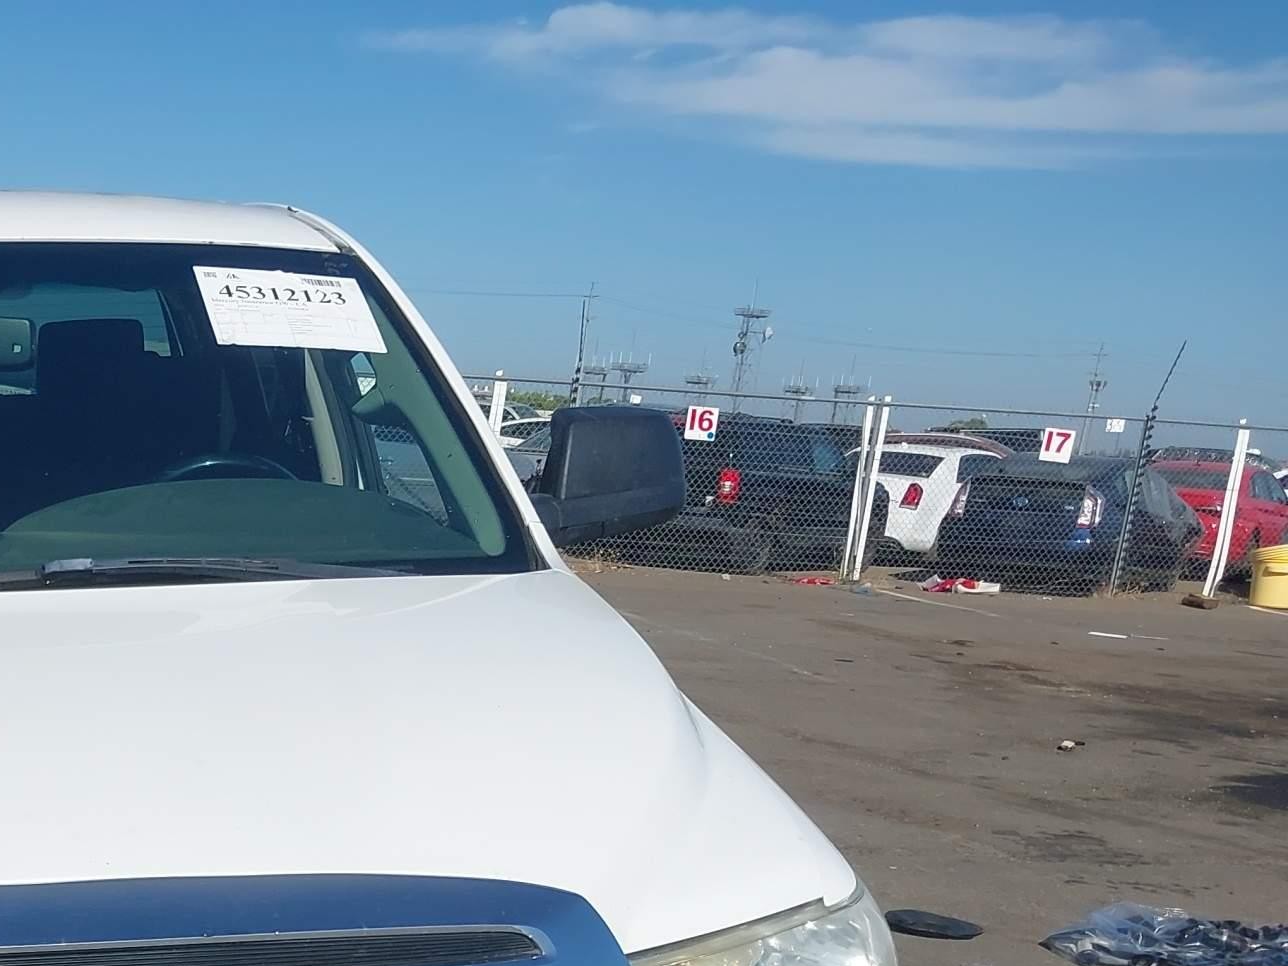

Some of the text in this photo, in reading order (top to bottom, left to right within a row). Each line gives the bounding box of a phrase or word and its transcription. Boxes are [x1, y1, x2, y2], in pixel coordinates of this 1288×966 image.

[218, 283, 347, 306] 45312123
[689, 408, 715, 432] 16
[1044, 430, 1072, 454] 17
